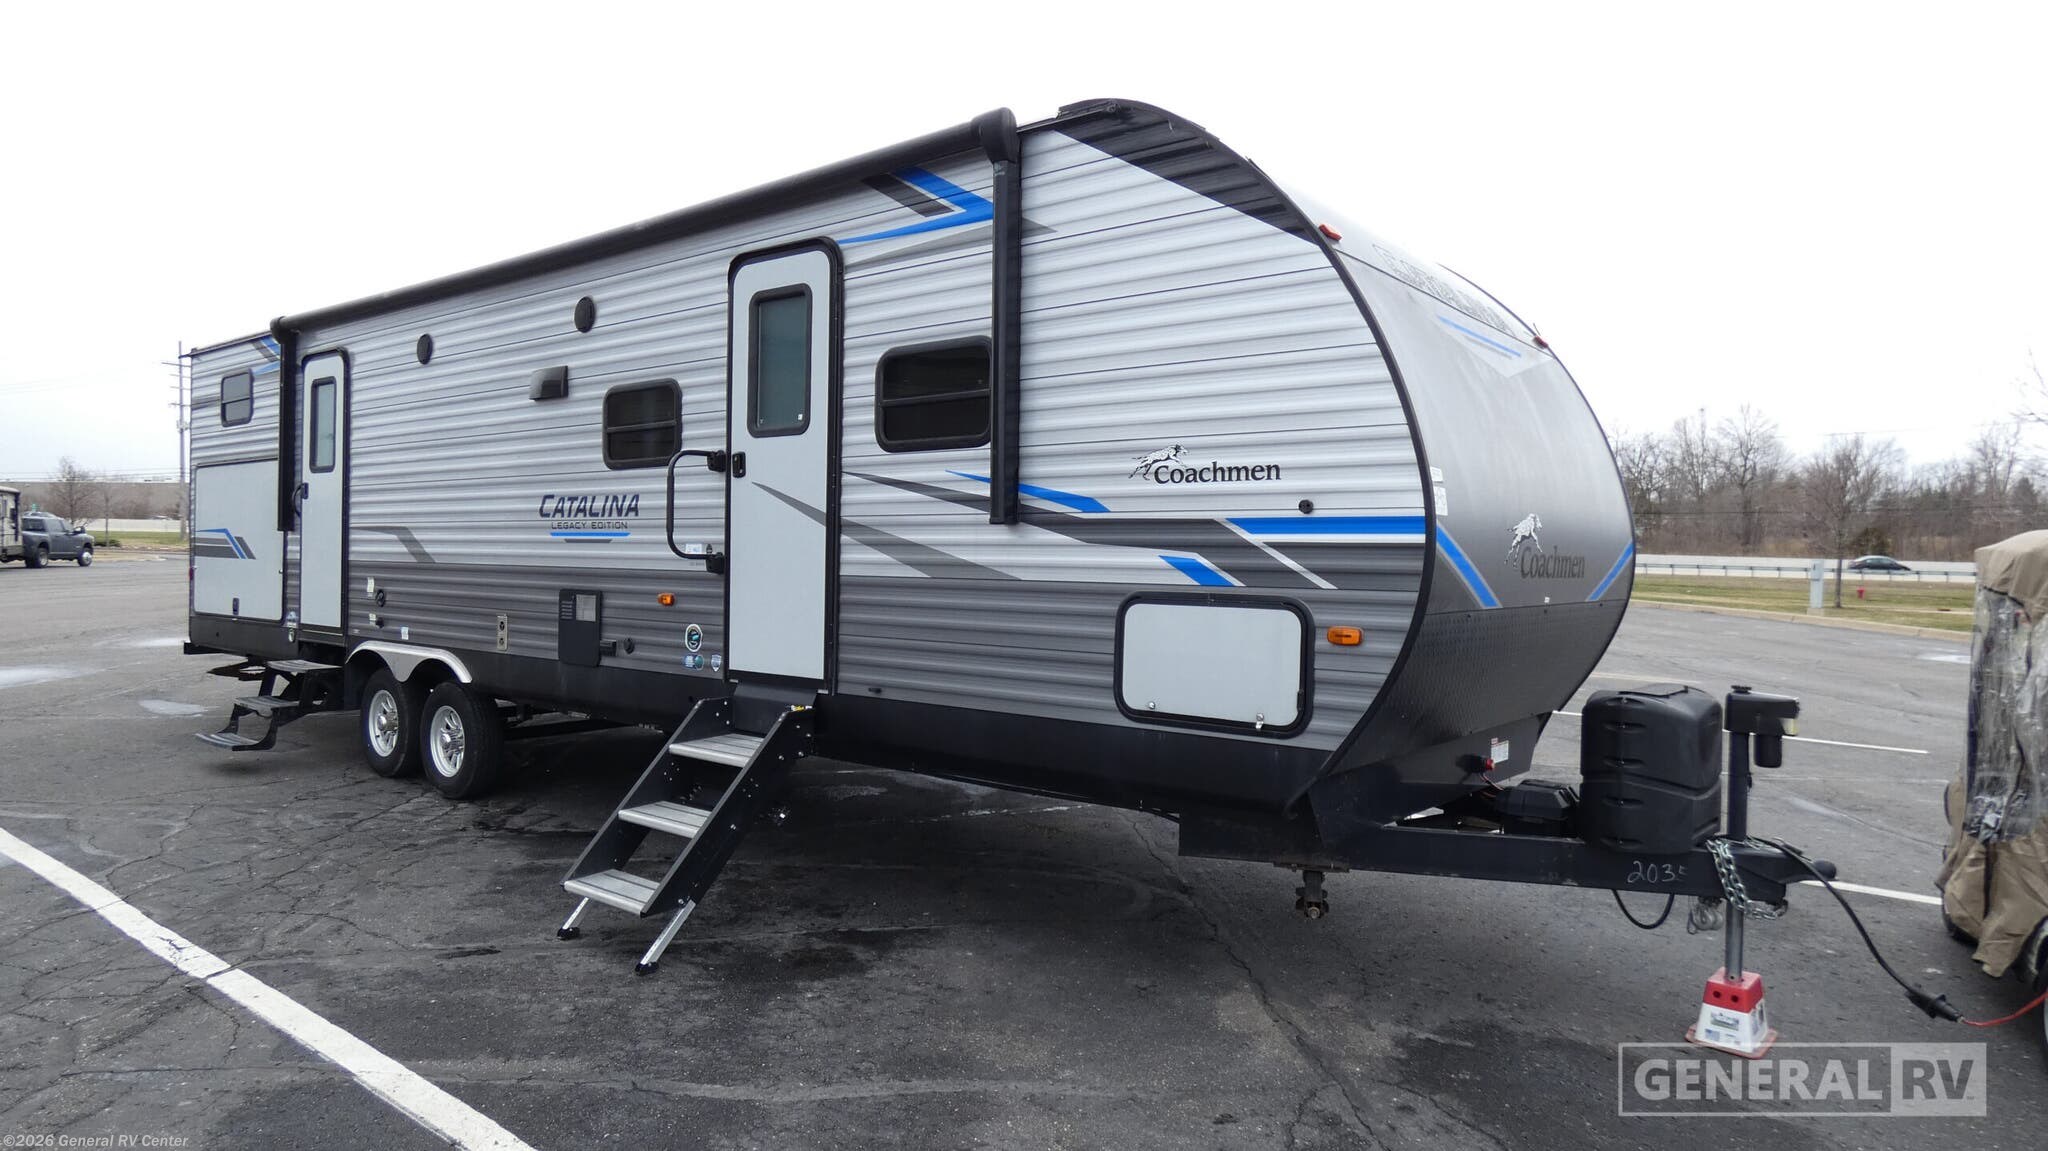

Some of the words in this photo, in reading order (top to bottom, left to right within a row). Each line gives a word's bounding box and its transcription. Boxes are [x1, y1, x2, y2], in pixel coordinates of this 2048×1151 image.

[1154, 461, 1281, 484] Coachmen
[539, 493, 640, 518] CATALINA
[551, 521, 587, 530] LEGACY
[591, 521, 628, 530] EDITION
[1520, 545, 1585, 579] Coachmen
